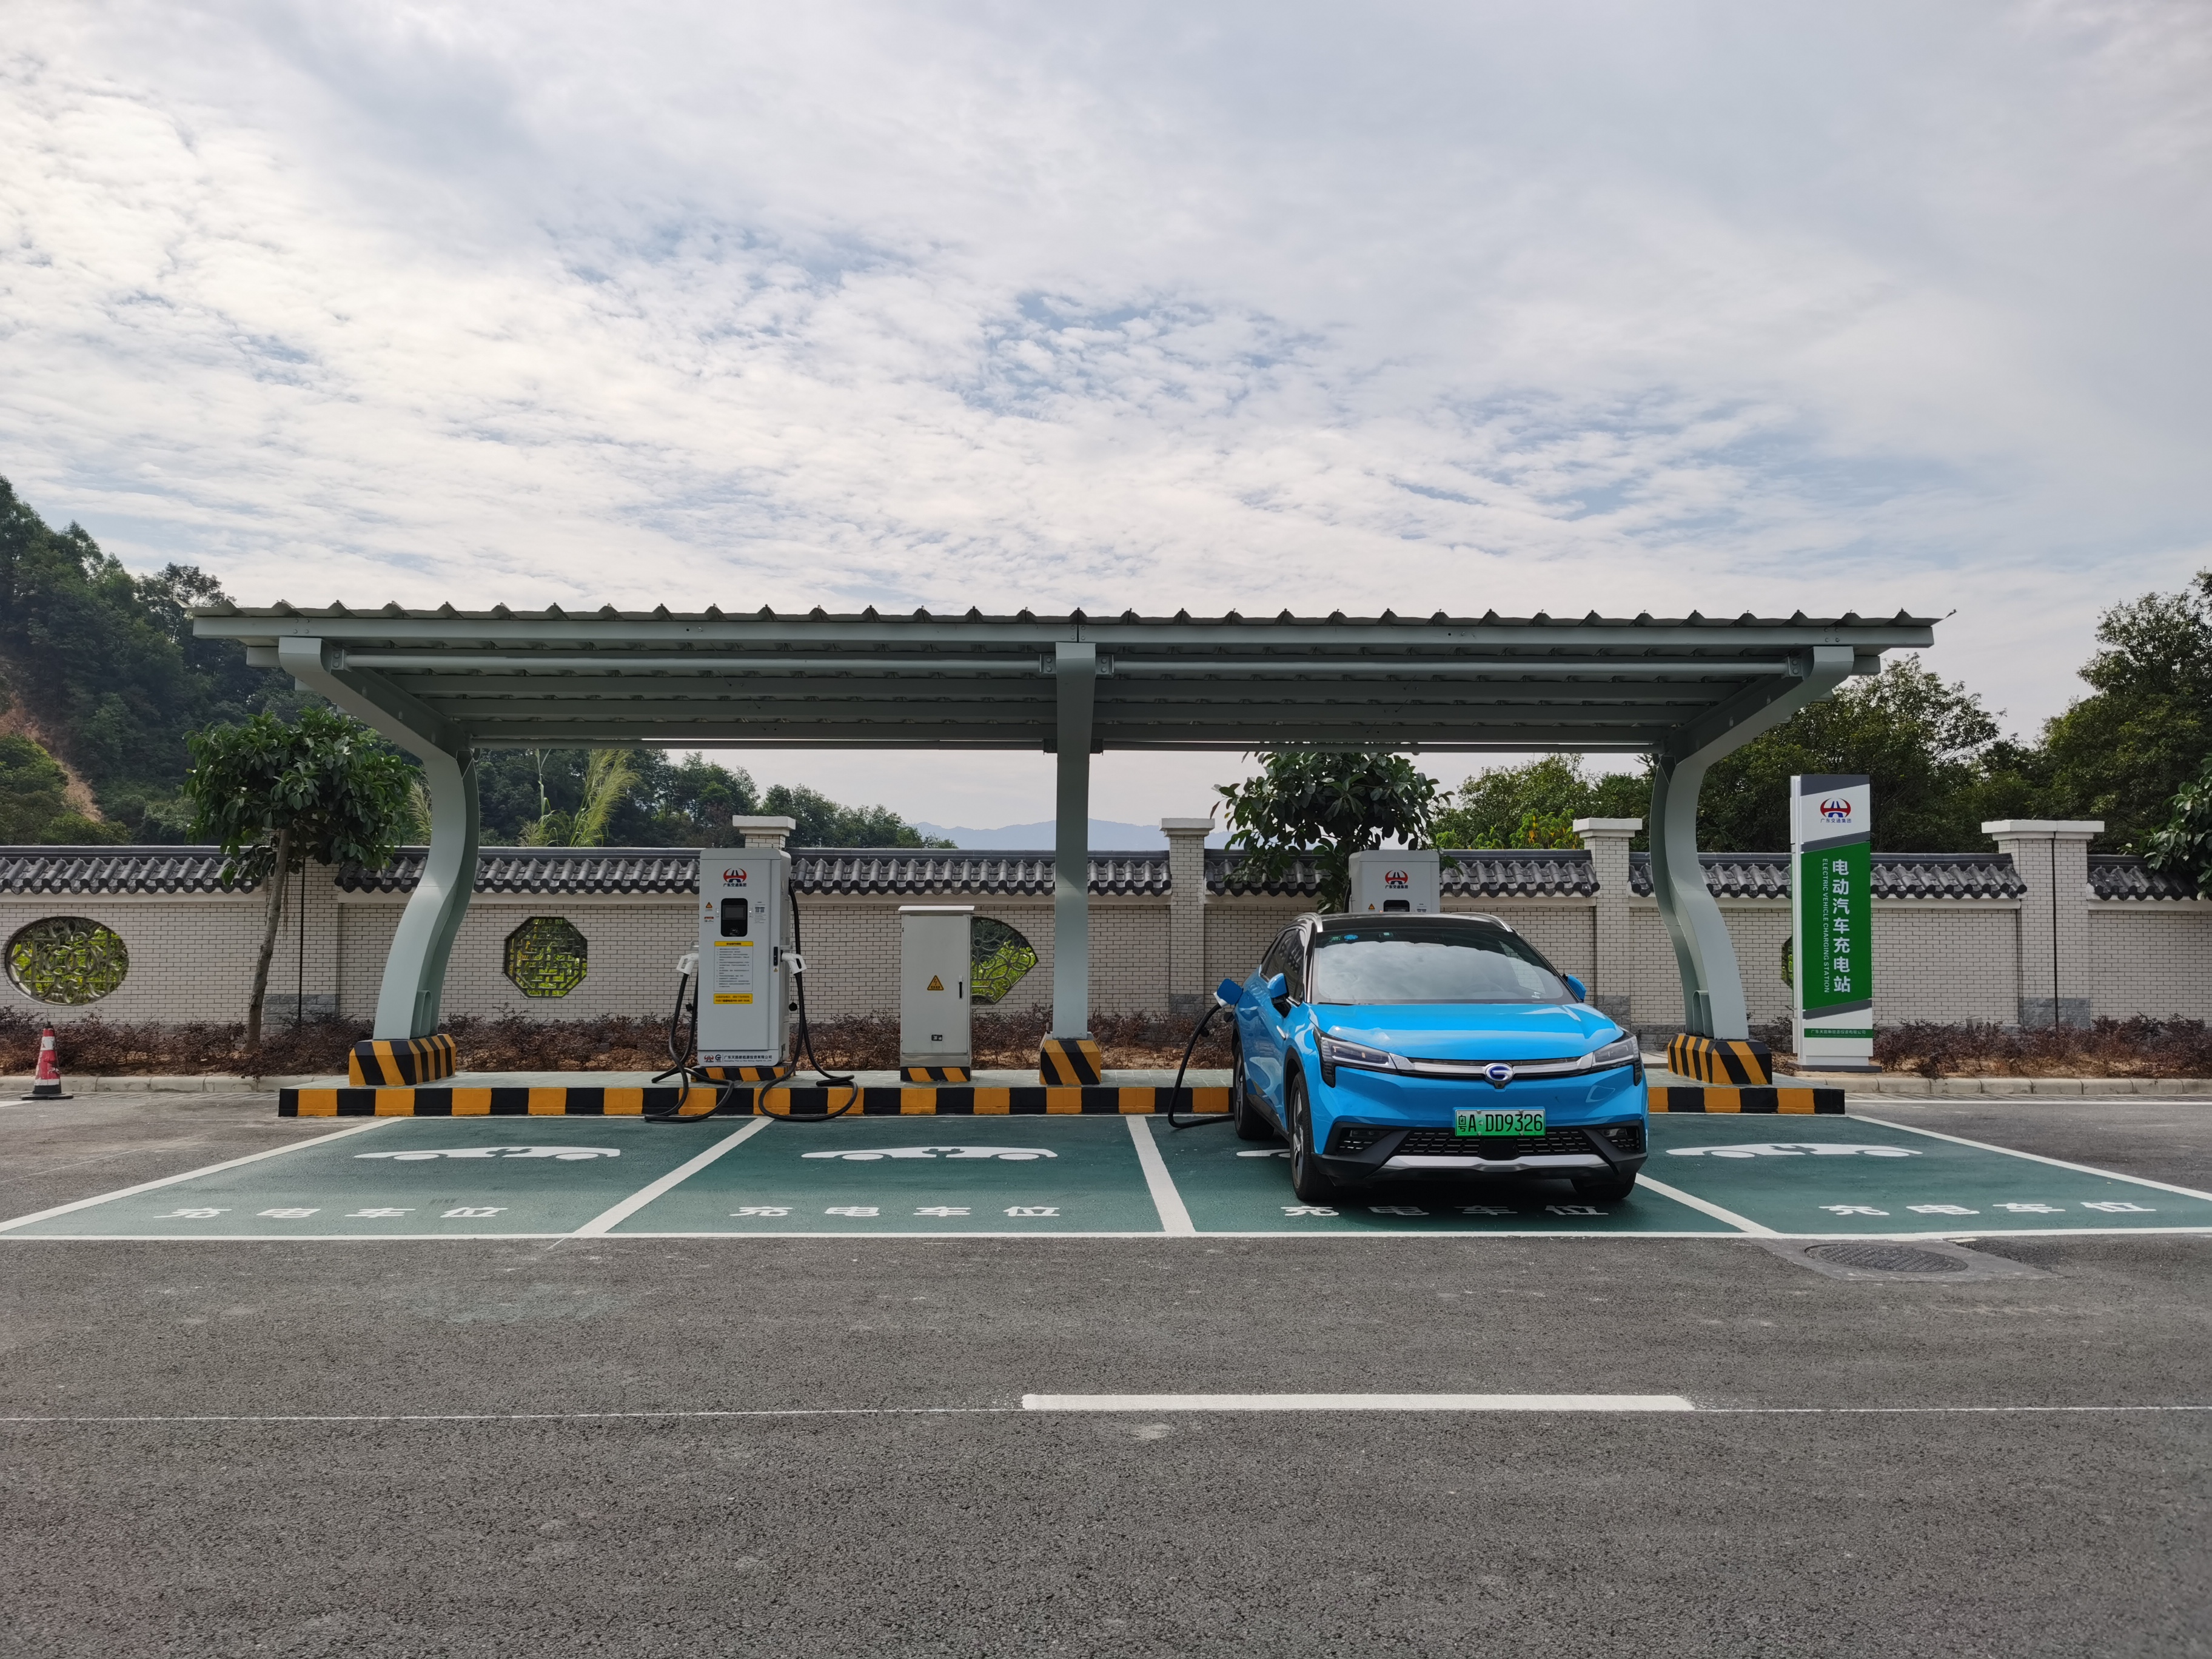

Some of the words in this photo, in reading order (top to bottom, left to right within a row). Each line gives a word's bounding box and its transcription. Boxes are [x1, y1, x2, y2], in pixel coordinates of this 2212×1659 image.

[1832, 859, 1851, 993] 电动汽车充电站
[153, 1207, 508, 1218] 充电车位
[729, 1207, 1061, 1217] 充电车位
[1281, 1205, 1609, 1216] 充电车位
[1819, 1202, 2157, 1215] 充电车位
